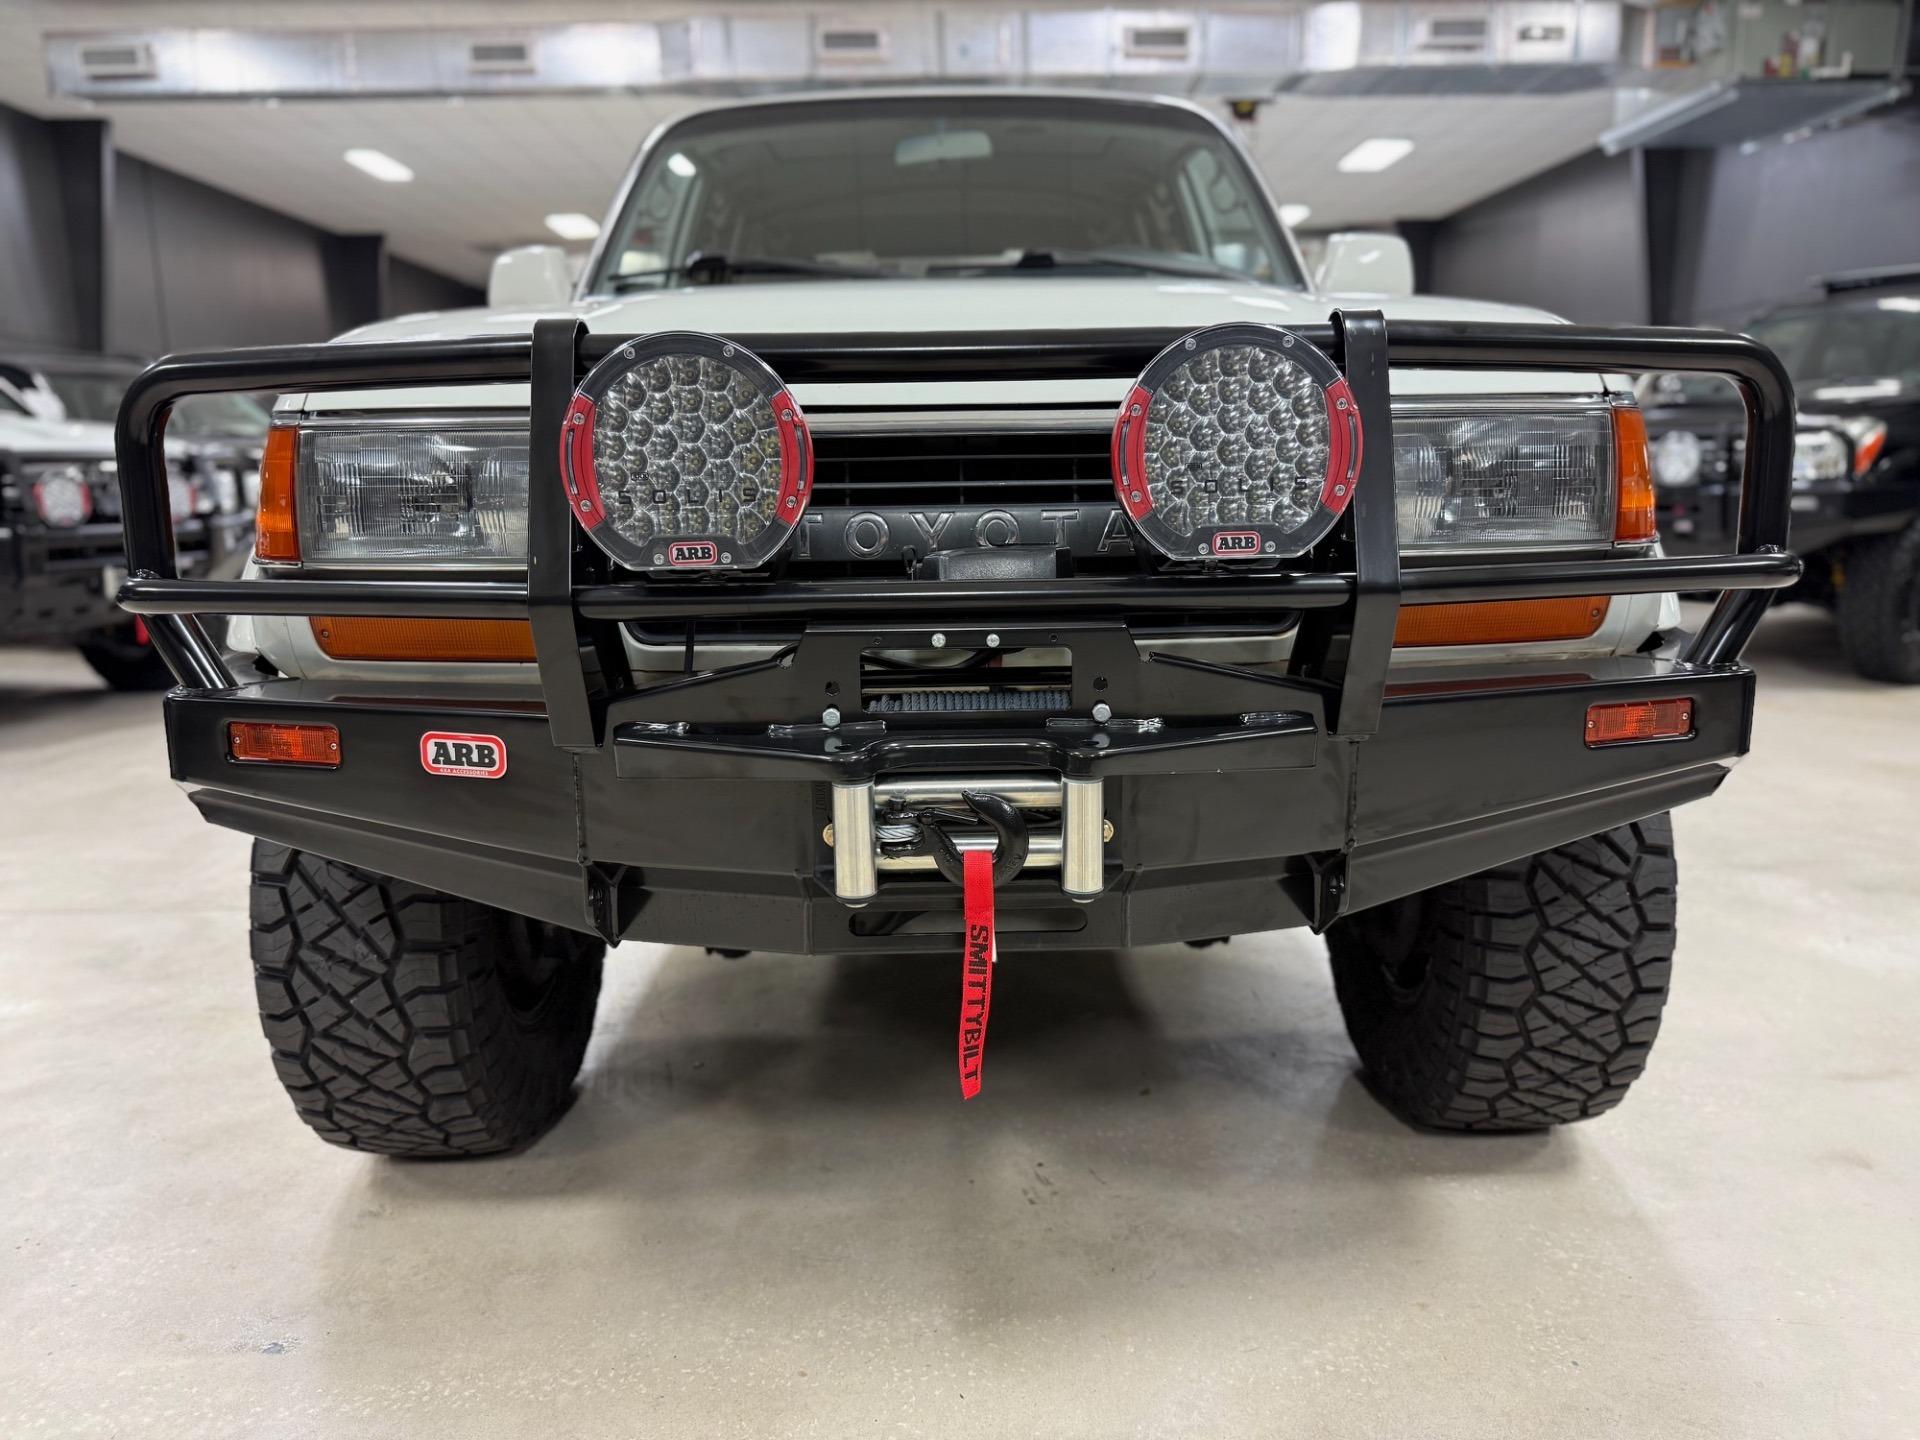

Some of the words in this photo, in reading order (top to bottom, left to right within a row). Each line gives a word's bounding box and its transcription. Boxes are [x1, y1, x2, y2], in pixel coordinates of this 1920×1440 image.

[1171, 477, 1308, 495] SOLIS
[618, 487, 757, 504] SOLIS
[799, 508, 1136, 559] TOYOTA
[1217, 536, 1256, 551] ARB
[674, 546, 713, 561] ARB
[432, 742, 496, 768] ARB
[964, 924, 989, 1080] SMITTYBILT
